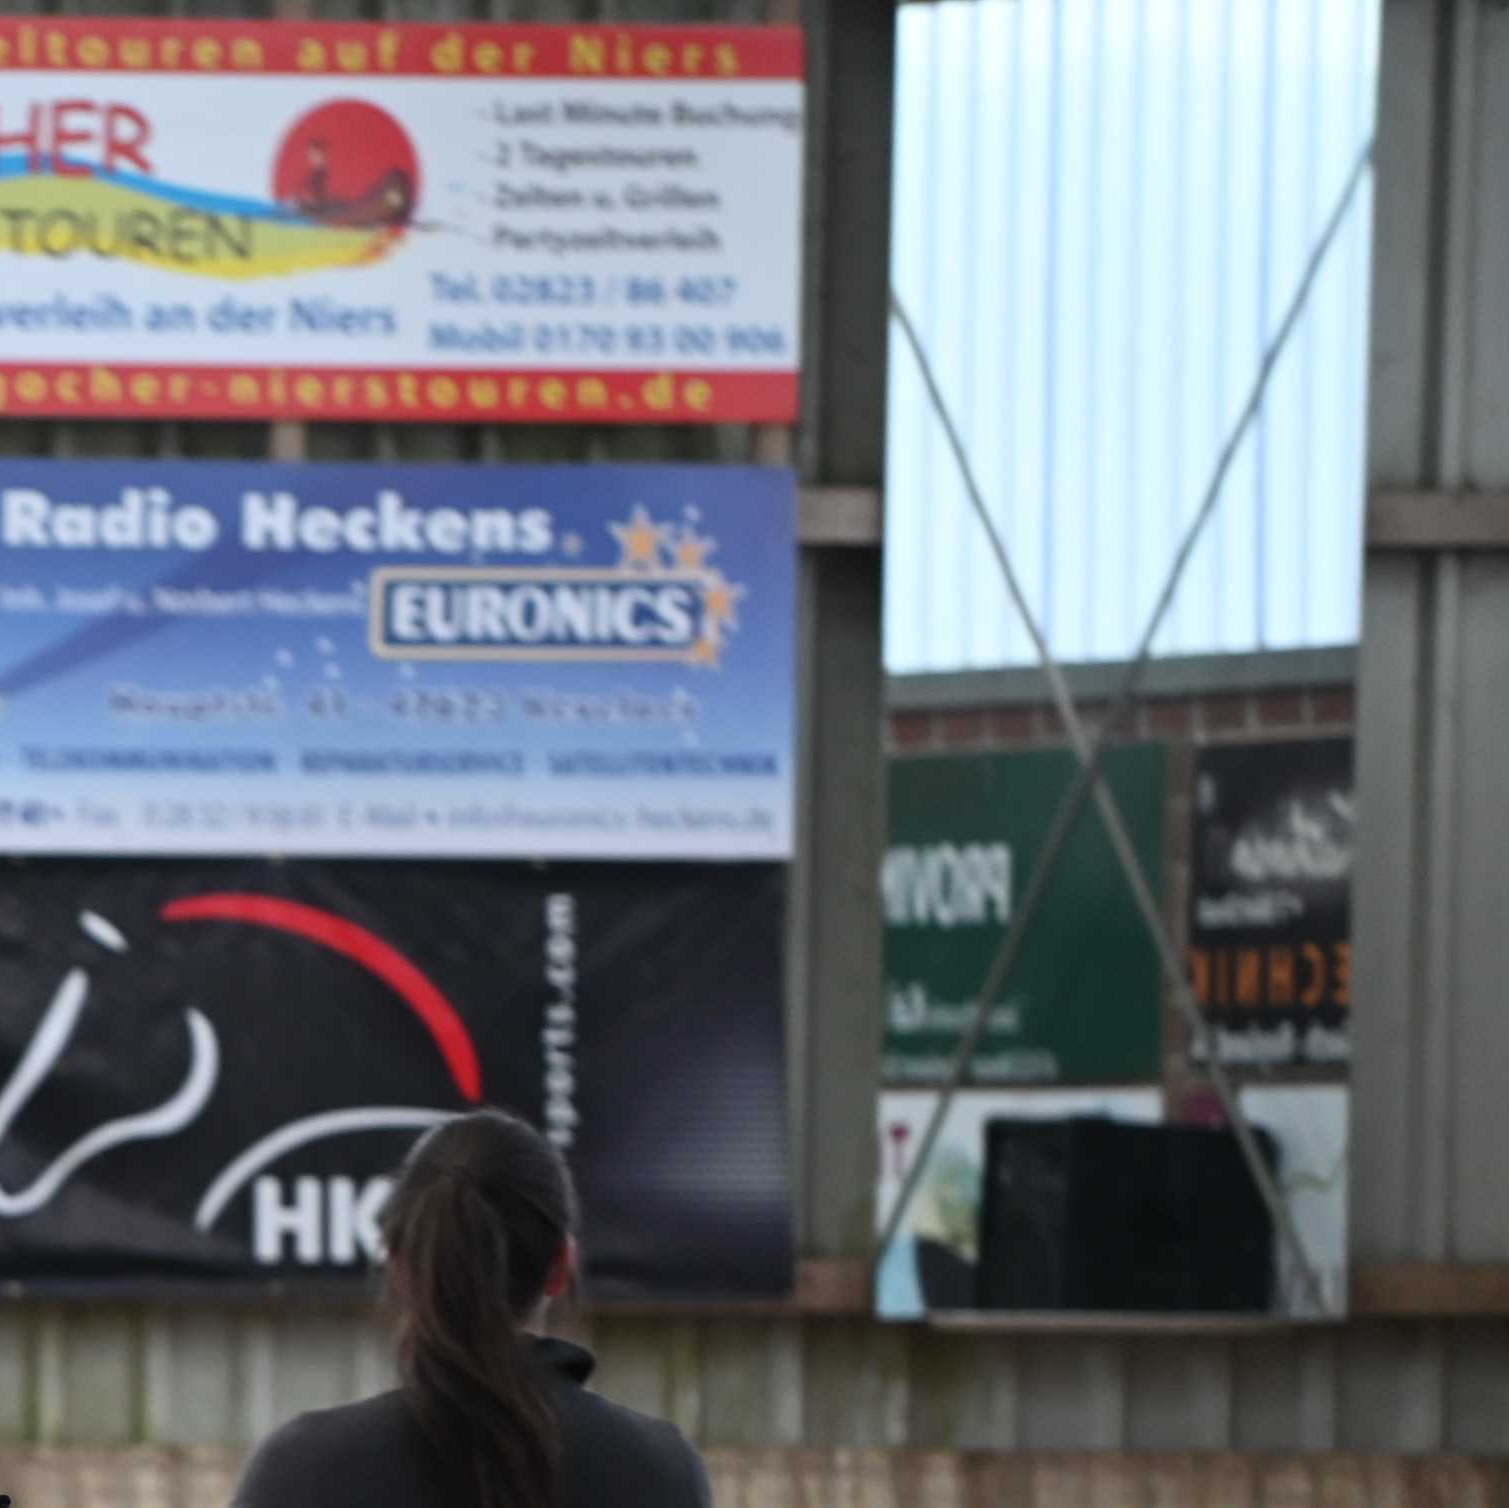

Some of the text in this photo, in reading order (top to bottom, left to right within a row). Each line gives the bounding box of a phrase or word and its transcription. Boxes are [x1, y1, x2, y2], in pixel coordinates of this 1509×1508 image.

[296, 30, 399, 73] auf
[430, 31, 535, 75] der
[568, 32, 740, 78] Niers
[146, 302, 198, 333] an
[207, 298, 277, 334] der
[289, 299, 399, 337] Niers
[1, 487, 553, 554] Radio Heckens
[390, 583, 693, 644] EURONICS
